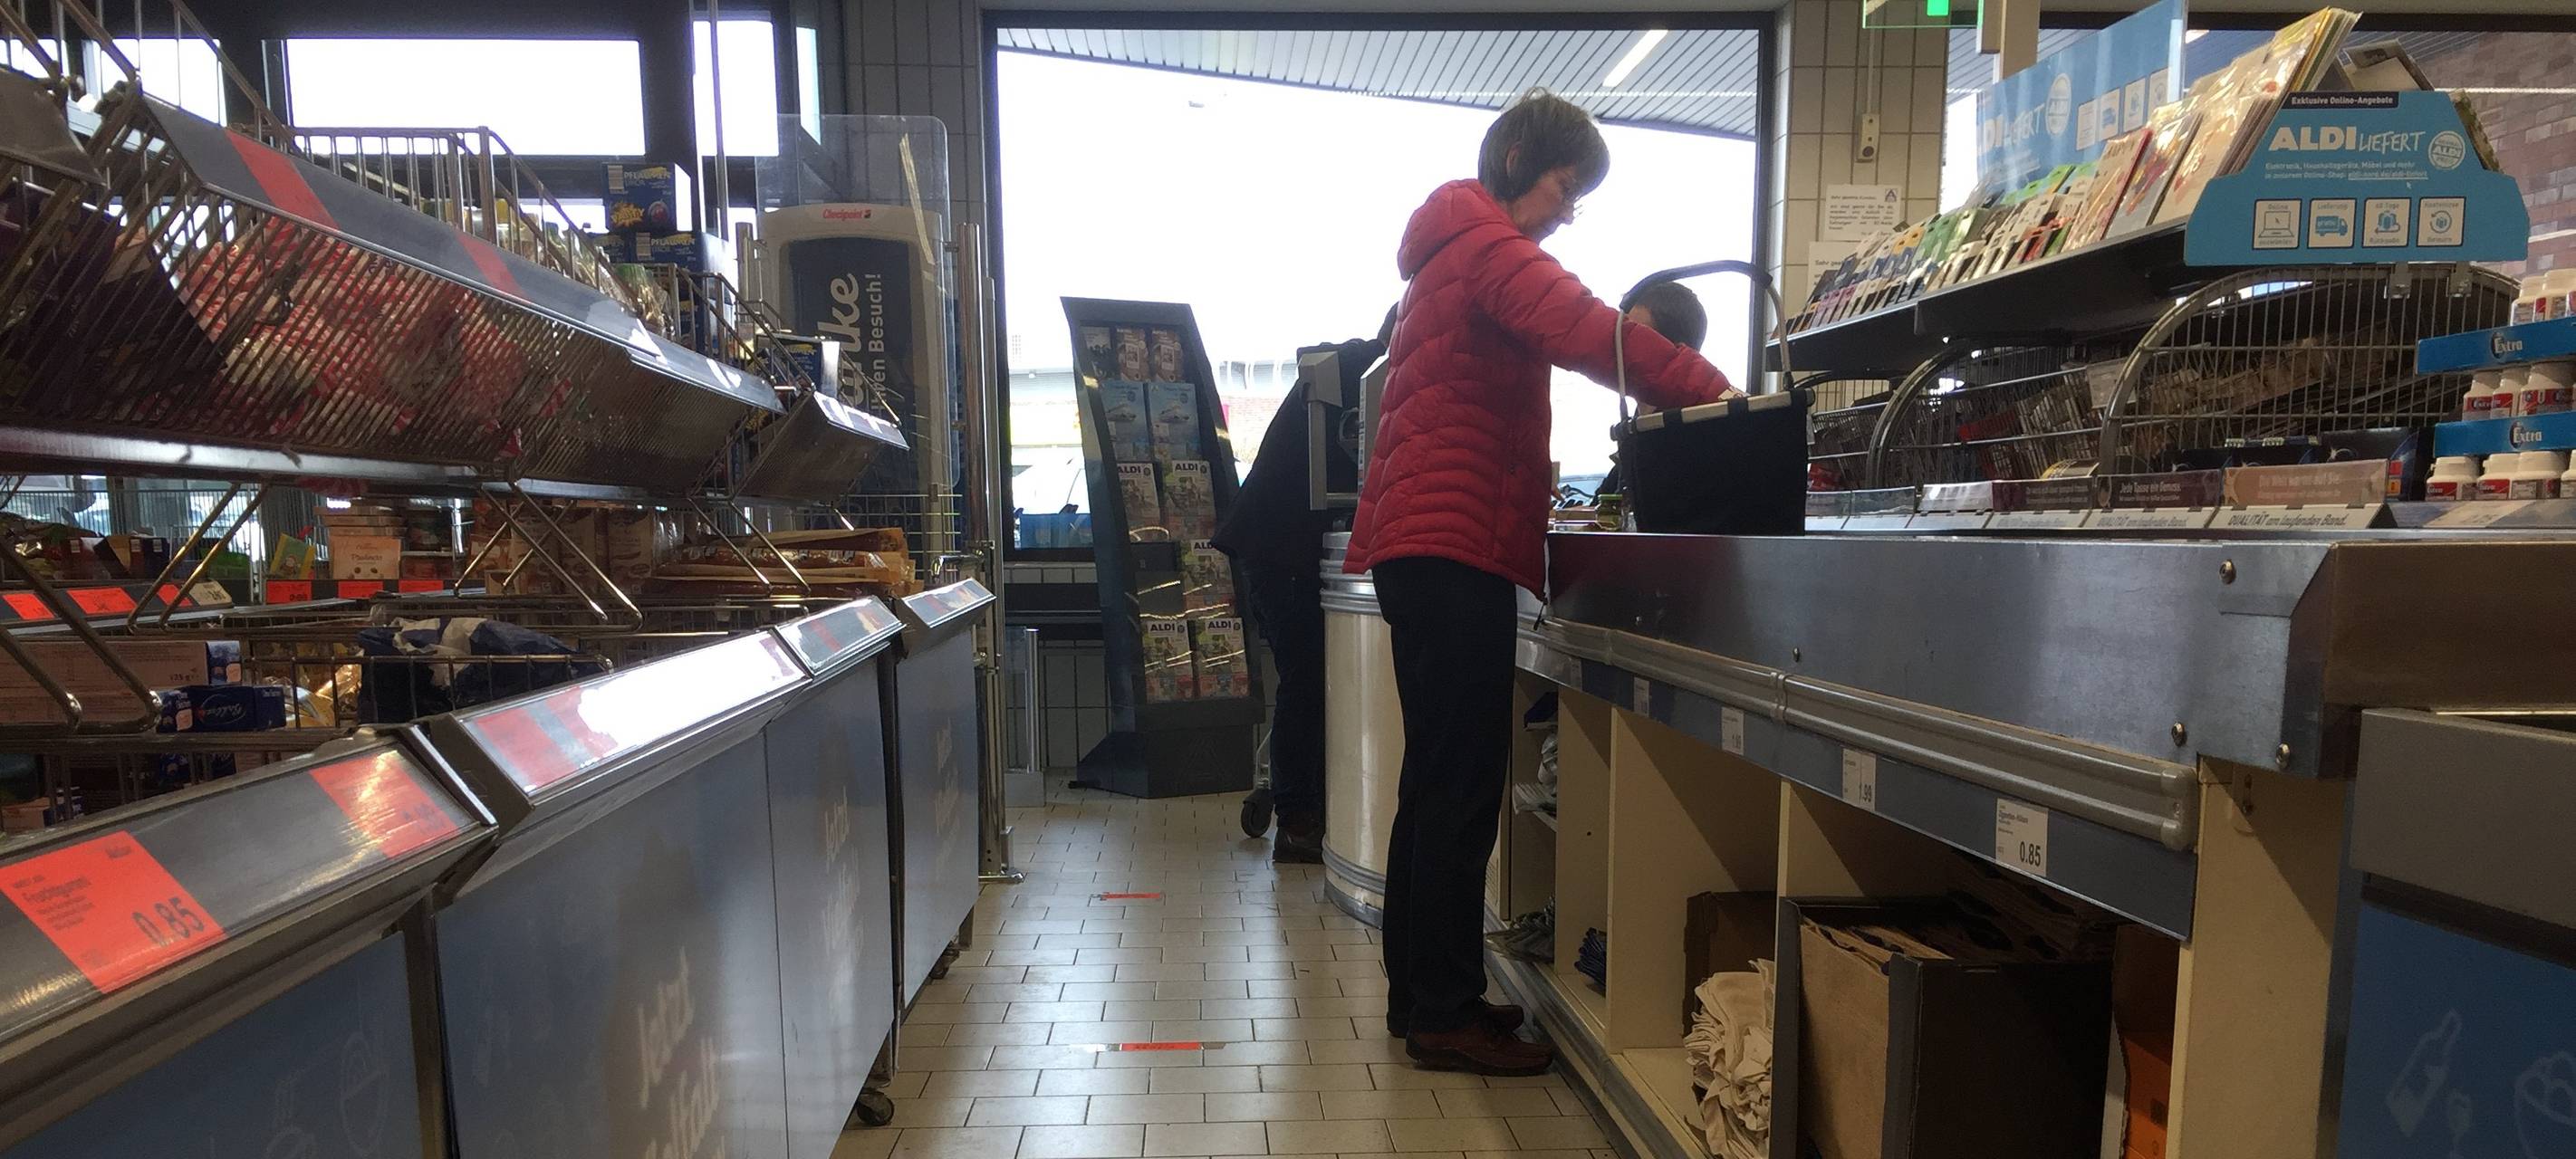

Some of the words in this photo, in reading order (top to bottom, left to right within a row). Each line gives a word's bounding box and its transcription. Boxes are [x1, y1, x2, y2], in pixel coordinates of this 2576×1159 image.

[2291, 96, 2329, 106] Exklusive
[2329, 96, 2394, 106] Online-Angebote
[2268, 126, 2357, 151] ALDI
[2358, 129, 2427, 153] LIEFERT
[865, 273, 885, 352] Besuch!
[817, 273, 863, 409] anke
[2494, 336, 2523, 355] Extra
[2512, 427, 2542, 445] Extra
[1175, 463, 1199, 472] ALDI
[2227, 511, 2269, 526] QUALITÄT
[2279, 514, 2321, 529] laufenden
[1194, 541, 1219, 550] ALD
[1149, 623, 1176, 633] ALDI
[1206, 620, 1232, 630] ALDI
[2019, 840, 2042, 867] 0.85
[131, 896, 206, 947] 0.85
